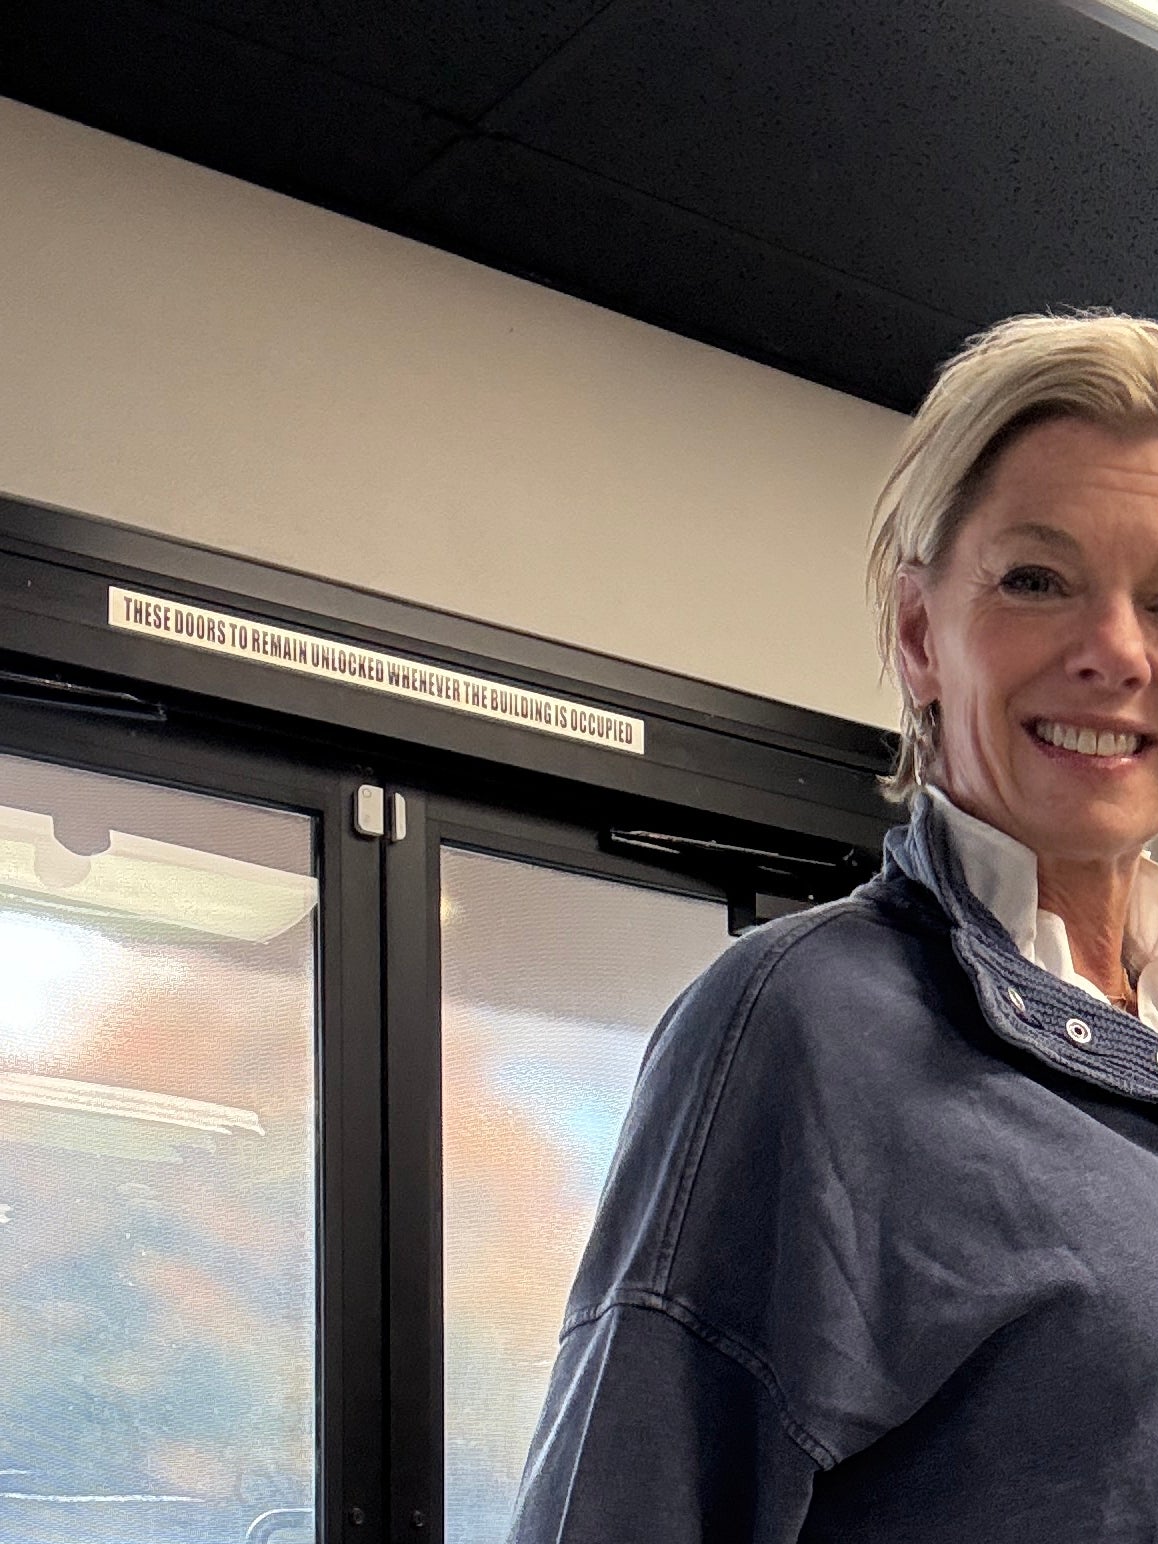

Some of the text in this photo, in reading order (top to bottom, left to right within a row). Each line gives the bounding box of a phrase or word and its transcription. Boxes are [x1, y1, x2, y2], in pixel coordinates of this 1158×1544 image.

[123, 595, 633, 745] THESE DOORS TO REMAIN UNLOCKED WHENEVER THE BUILDING IS OCCUPIED
